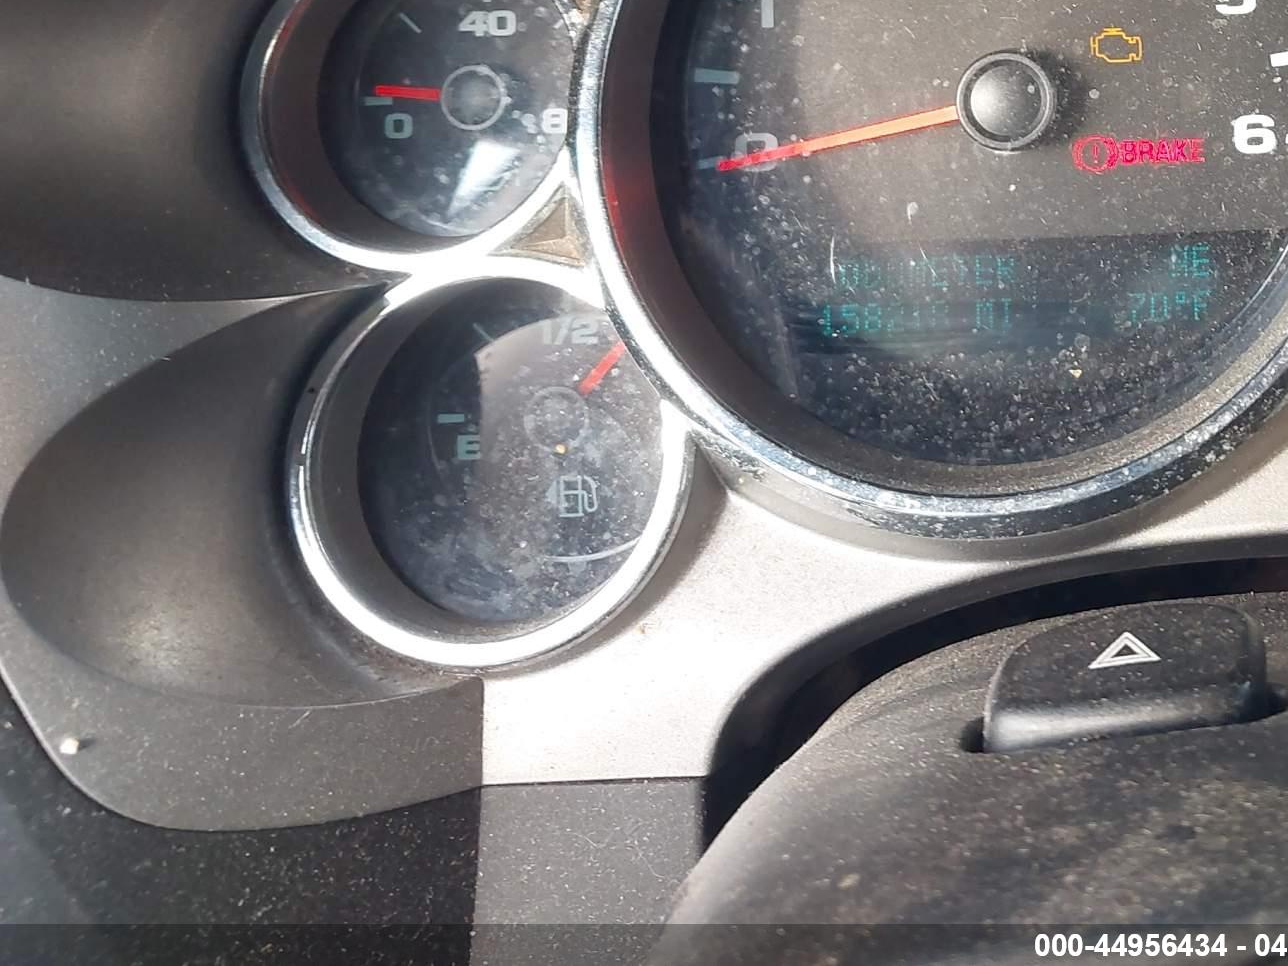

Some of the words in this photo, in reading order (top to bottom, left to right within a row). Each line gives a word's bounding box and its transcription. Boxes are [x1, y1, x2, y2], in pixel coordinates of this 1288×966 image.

[459, 10, 516, 36] 40
[386, 113, 413, 138] 0
[1231, 113, 1277, 154] 6
[735, 132, 778, 171] 0
[1120, 138, 1205, 164] BRAKE
[543, 315, 600, 345] 1/2
[457, 434, 481, 460] E
